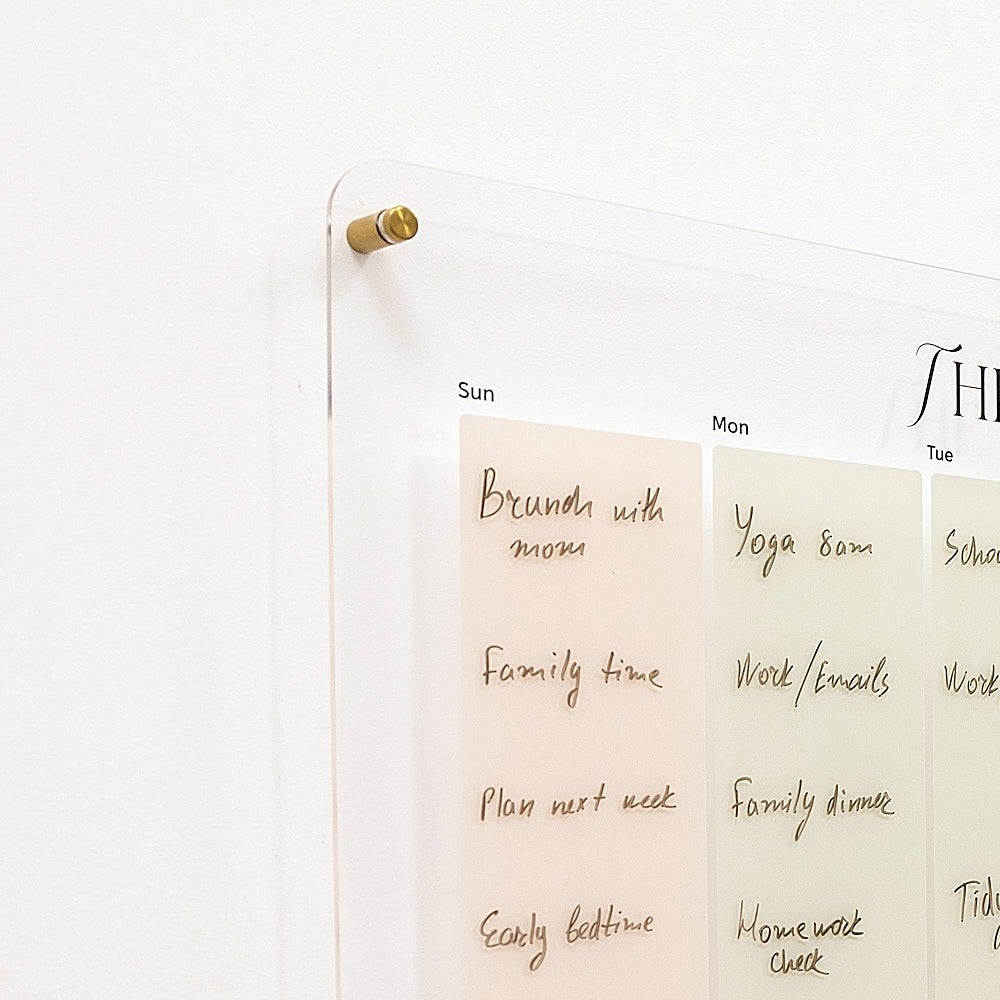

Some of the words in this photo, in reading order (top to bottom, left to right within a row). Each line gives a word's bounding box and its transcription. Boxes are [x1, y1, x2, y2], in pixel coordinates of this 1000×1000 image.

[458, 381, 494, 402] Sun
[713, 415, 749, 435] Mon
[927, 445, 953, 463] Tue
[480, 467, 592, 520] Brunch
[613, 487, 665, 522] with
[509, 538, 585, 559] mom
[734, 503, 796, 578] Yoga
[820, 529, 873, 556] 8am
[482, 645, 582, 708] Family
[602, 651, 663, 689] time
[481, 787, 534, 821] Plan
[552, 783, 606, 815] next
[623, 786, 677, 809] week
[732, 777, 815, 841] Family
[826, 784, 895, 817] dinner
[480, 910, 547, 971] Early
[566, 905, 654, 943] bedtime
